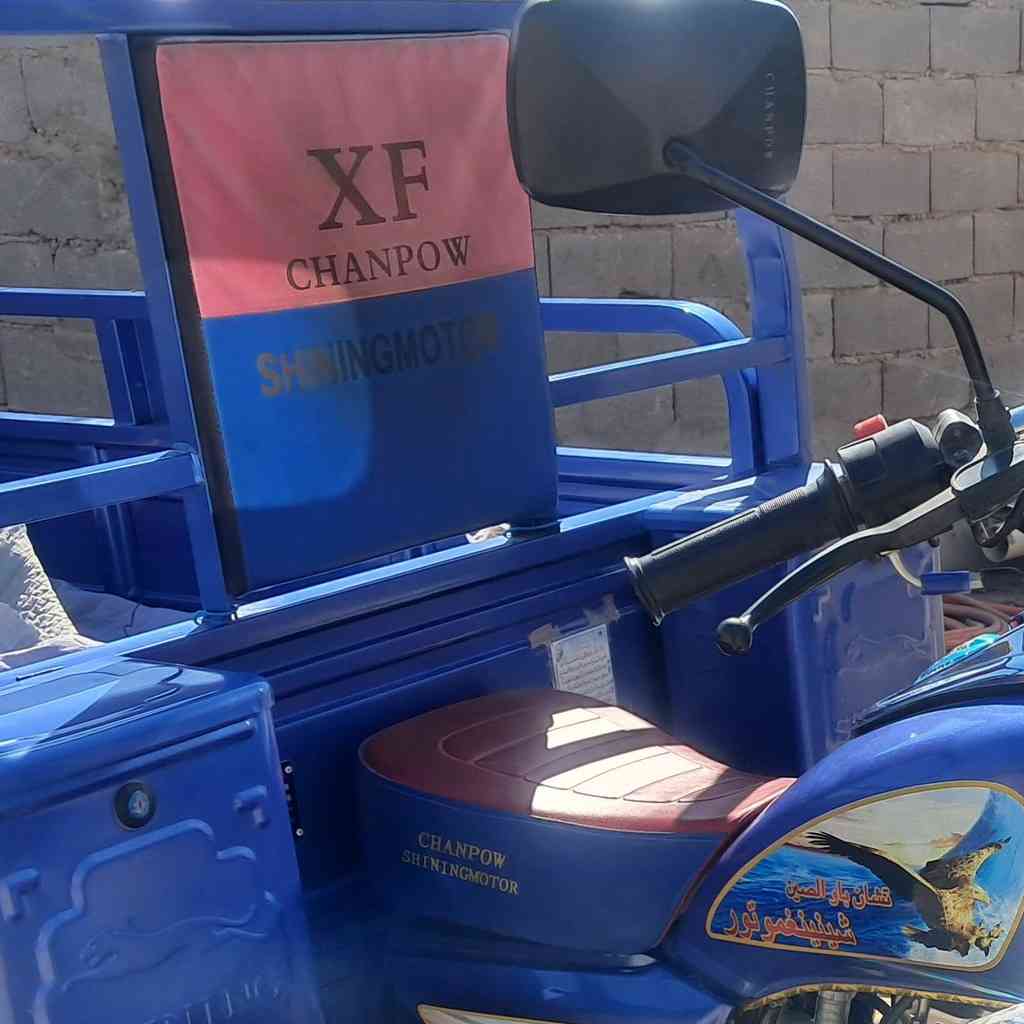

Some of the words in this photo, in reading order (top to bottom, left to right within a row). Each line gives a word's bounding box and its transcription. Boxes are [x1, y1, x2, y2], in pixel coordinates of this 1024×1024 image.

[306, 140, 429, 231] XF
[286, 235, 471, 291] CHANPOW
[400, 849, 520, 895] SHININGMOTOR
[418, 831, 506, 869] CHANPOW
[786, 877, 826, 902] الصين
